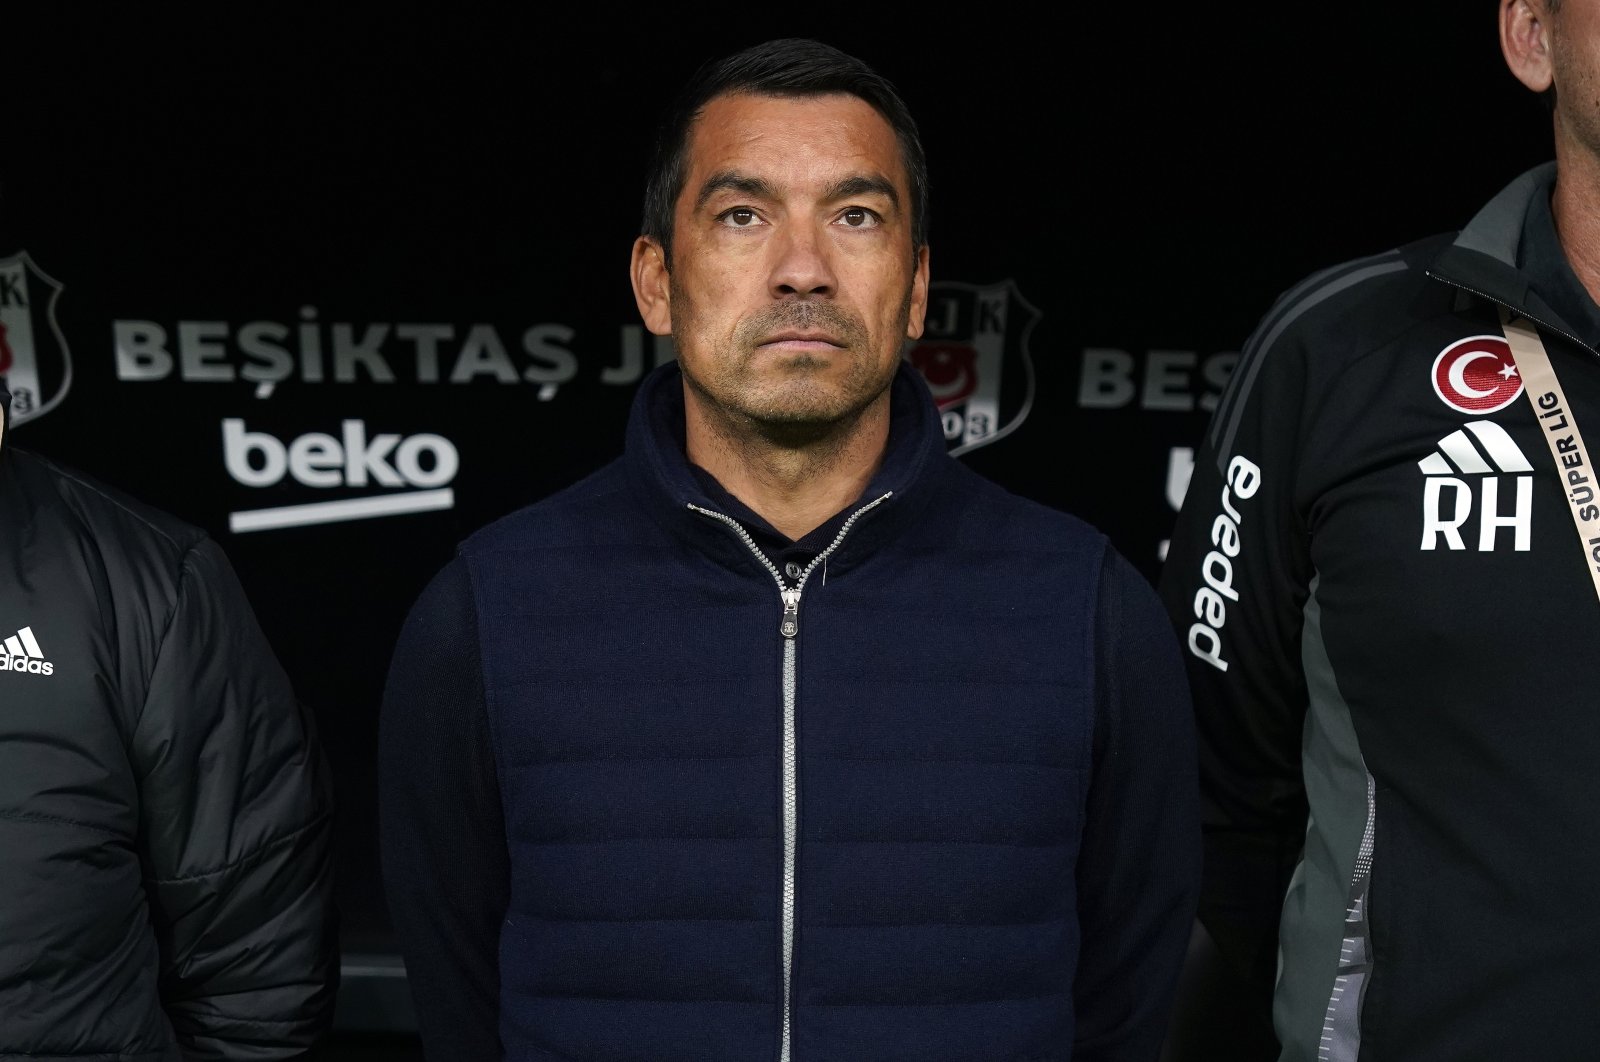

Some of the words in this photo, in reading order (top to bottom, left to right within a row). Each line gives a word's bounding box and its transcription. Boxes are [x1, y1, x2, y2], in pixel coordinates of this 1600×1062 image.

[928, 296, 1004, 337] JK
[111, 304, 580, 402] BEŞİKTAŞ
[600, 322, 678, 386] J
[941, 410, 990, 441] 03
[1537, 391, 1569, 432] LİG
[221, 417, 460, 489] beko
[1555, 434, 1600, 521] SÜPER
[1420, 475, 1534, 552] RH
[1188, 455, 1262, 672] papara
[0, 653, 54, 676] didas
